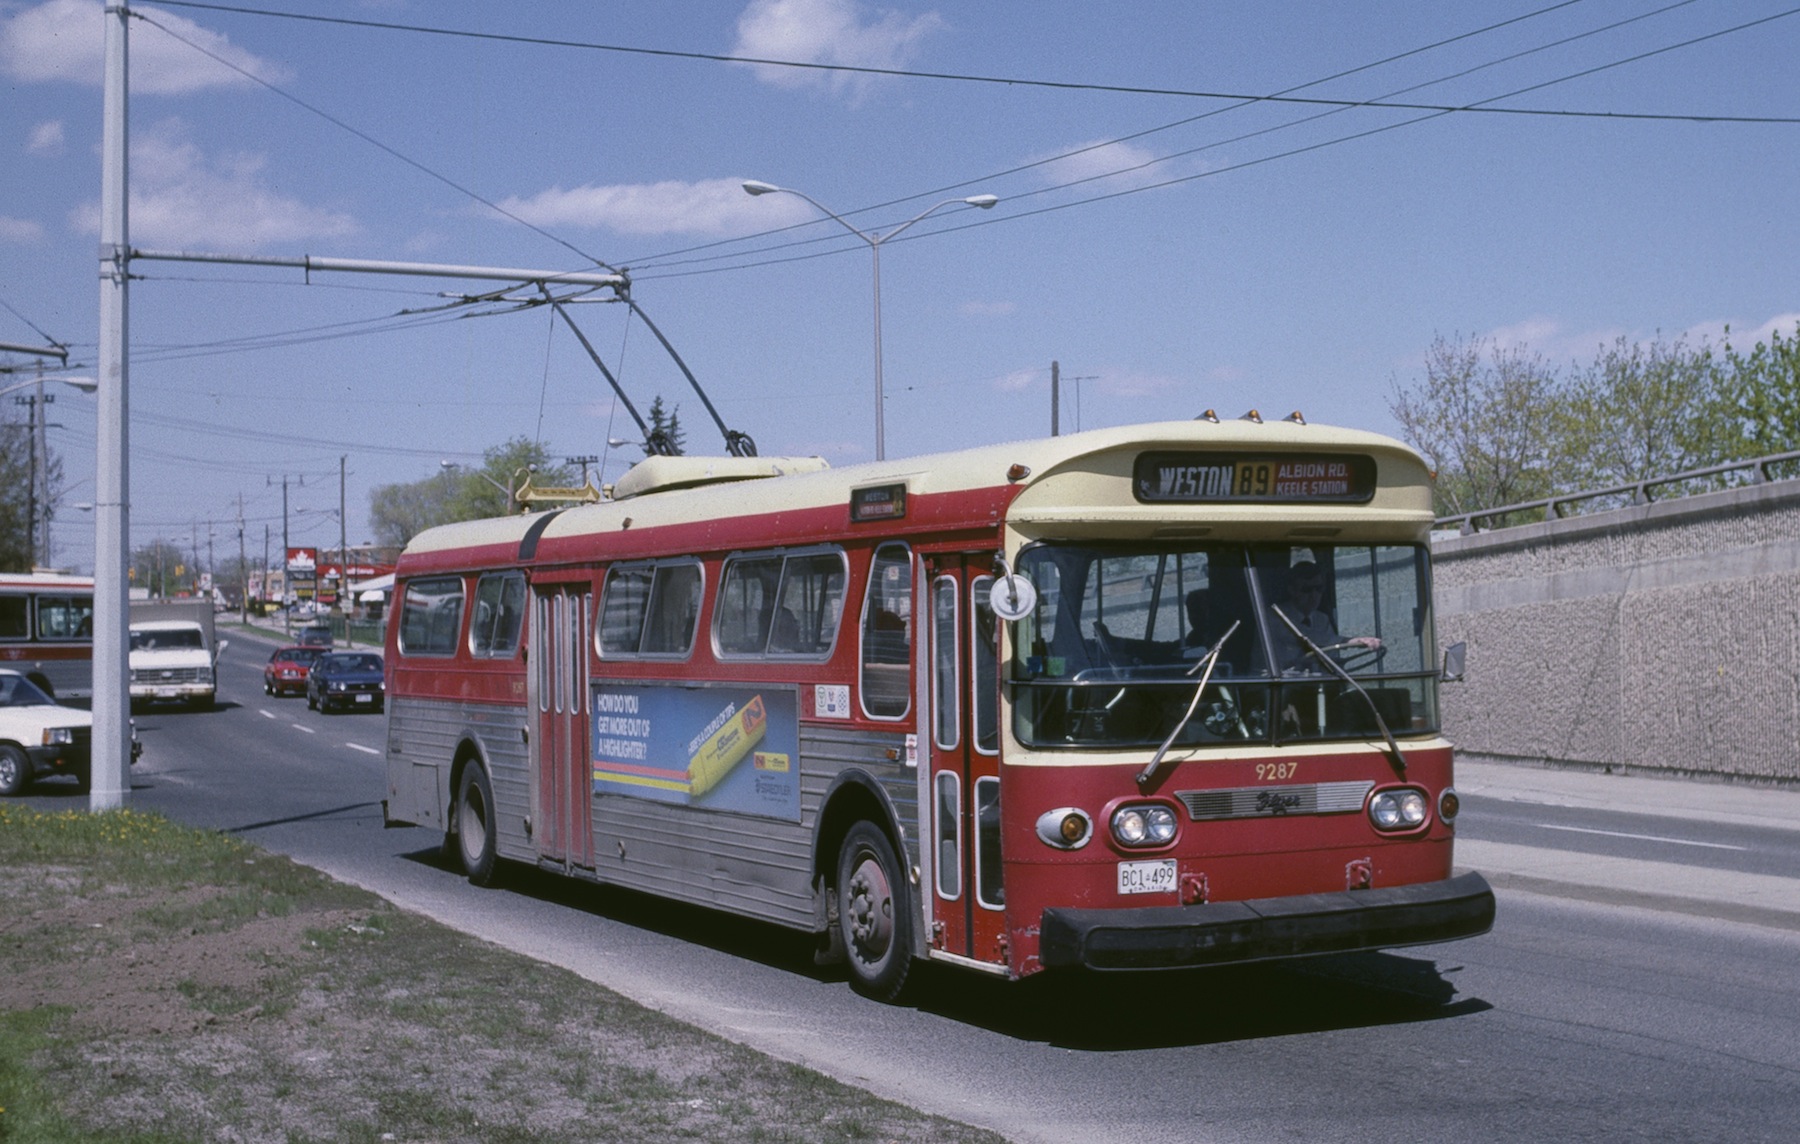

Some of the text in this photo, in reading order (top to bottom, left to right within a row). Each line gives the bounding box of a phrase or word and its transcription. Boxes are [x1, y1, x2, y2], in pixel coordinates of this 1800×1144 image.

[1278, 462, 1349, 479] ALBION RD.
[1159, 466, 1233, 496] WESTON
[1241, 465, 1270, 496] 89
[1276, 480, 1349, 496] KEELE STATION
[597, 693, 639, 714] HOW DO YOU
[598, 715, 651, 738] GET MORE OUT OF
[598, 737, 604, 755] A
[1255, 762, 1298, 780] 9287
